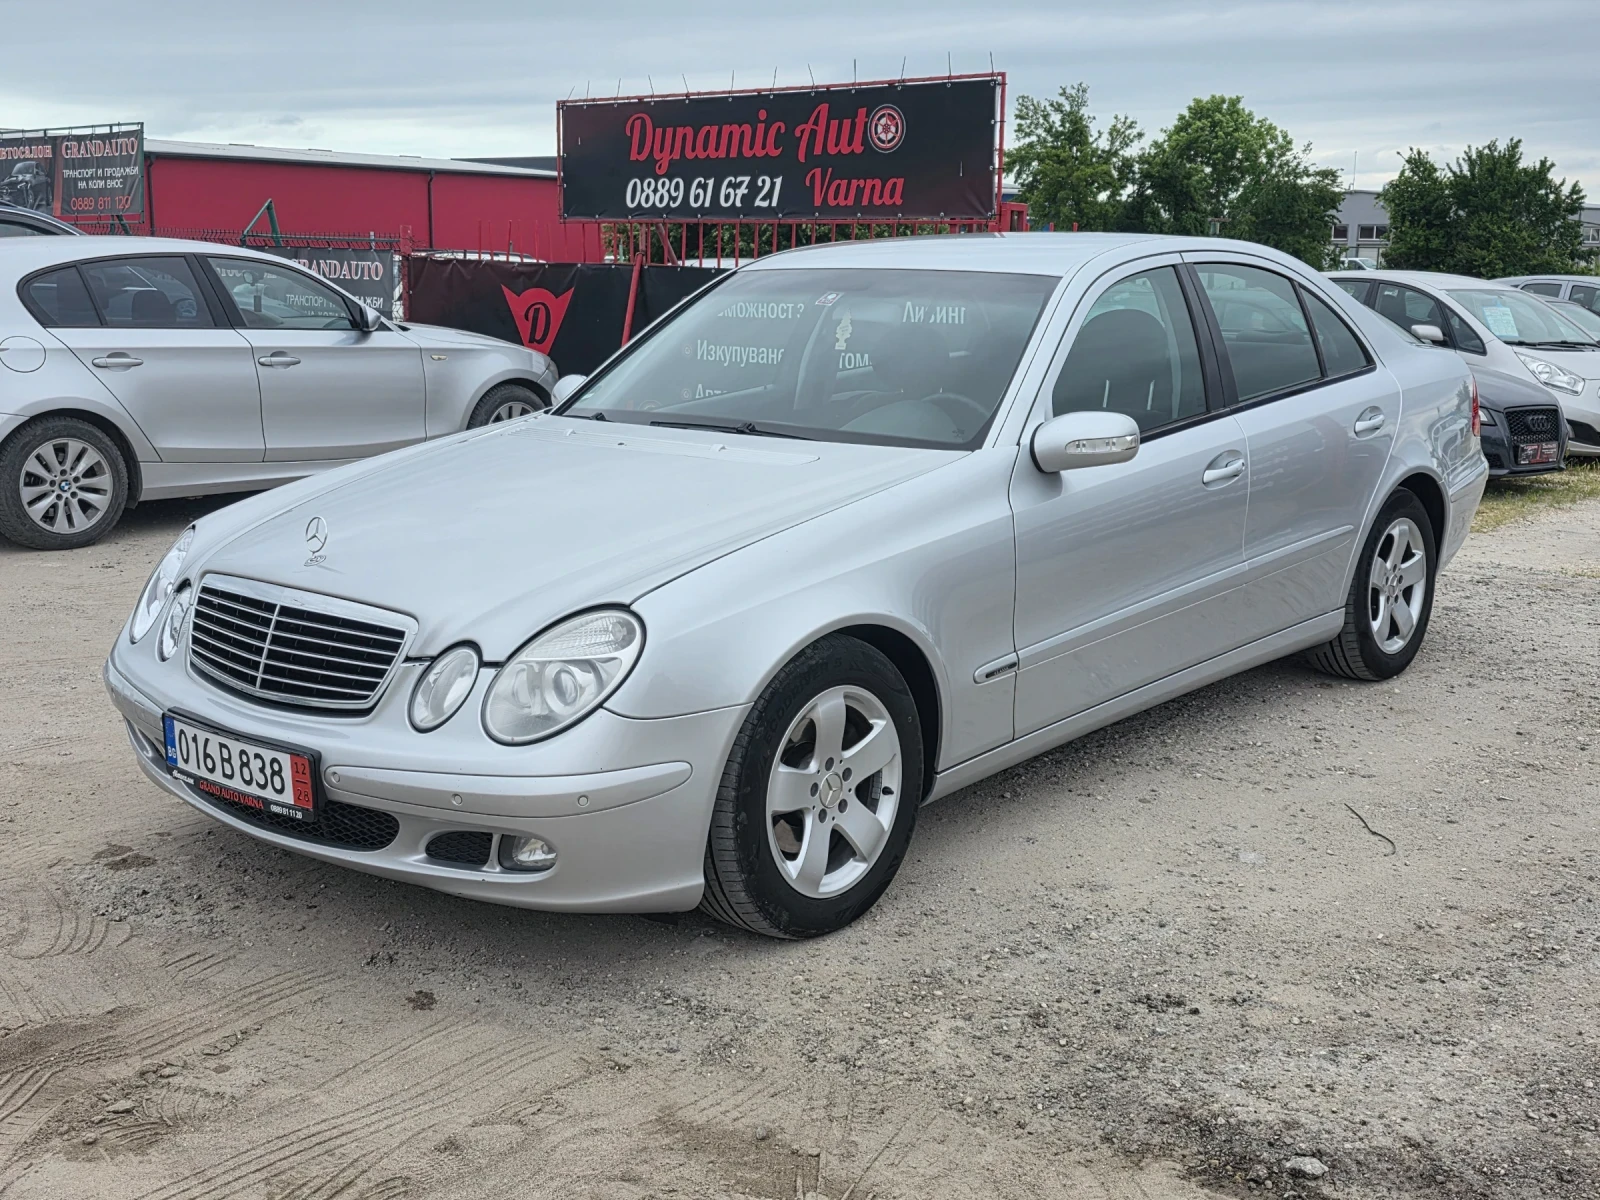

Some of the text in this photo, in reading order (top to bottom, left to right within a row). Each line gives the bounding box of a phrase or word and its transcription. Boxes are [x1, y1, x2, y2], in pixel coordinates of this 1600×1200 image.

[61, 137, 139, 159] GRANDAUTO
[625, 109, 786, 175] Dynamic
[62, 166, 139, 178] ТРАНСПОРТ И ПРОДАЖБИ
[77, 181, 88, 189] НА
[625, 175, 783, 208] 0889 61 67 21
[805, 167, 905, 207] Varna
[70, 195, 132, 211] 0889 811 120
[524, 301, 552, 345] D
[167, 745, 177, 759] BG
[294, 761, 307, 775] 12
[199, 780, 264, 810] GRAND AUTO VARNA
[297, 788, 309, 802] 28
